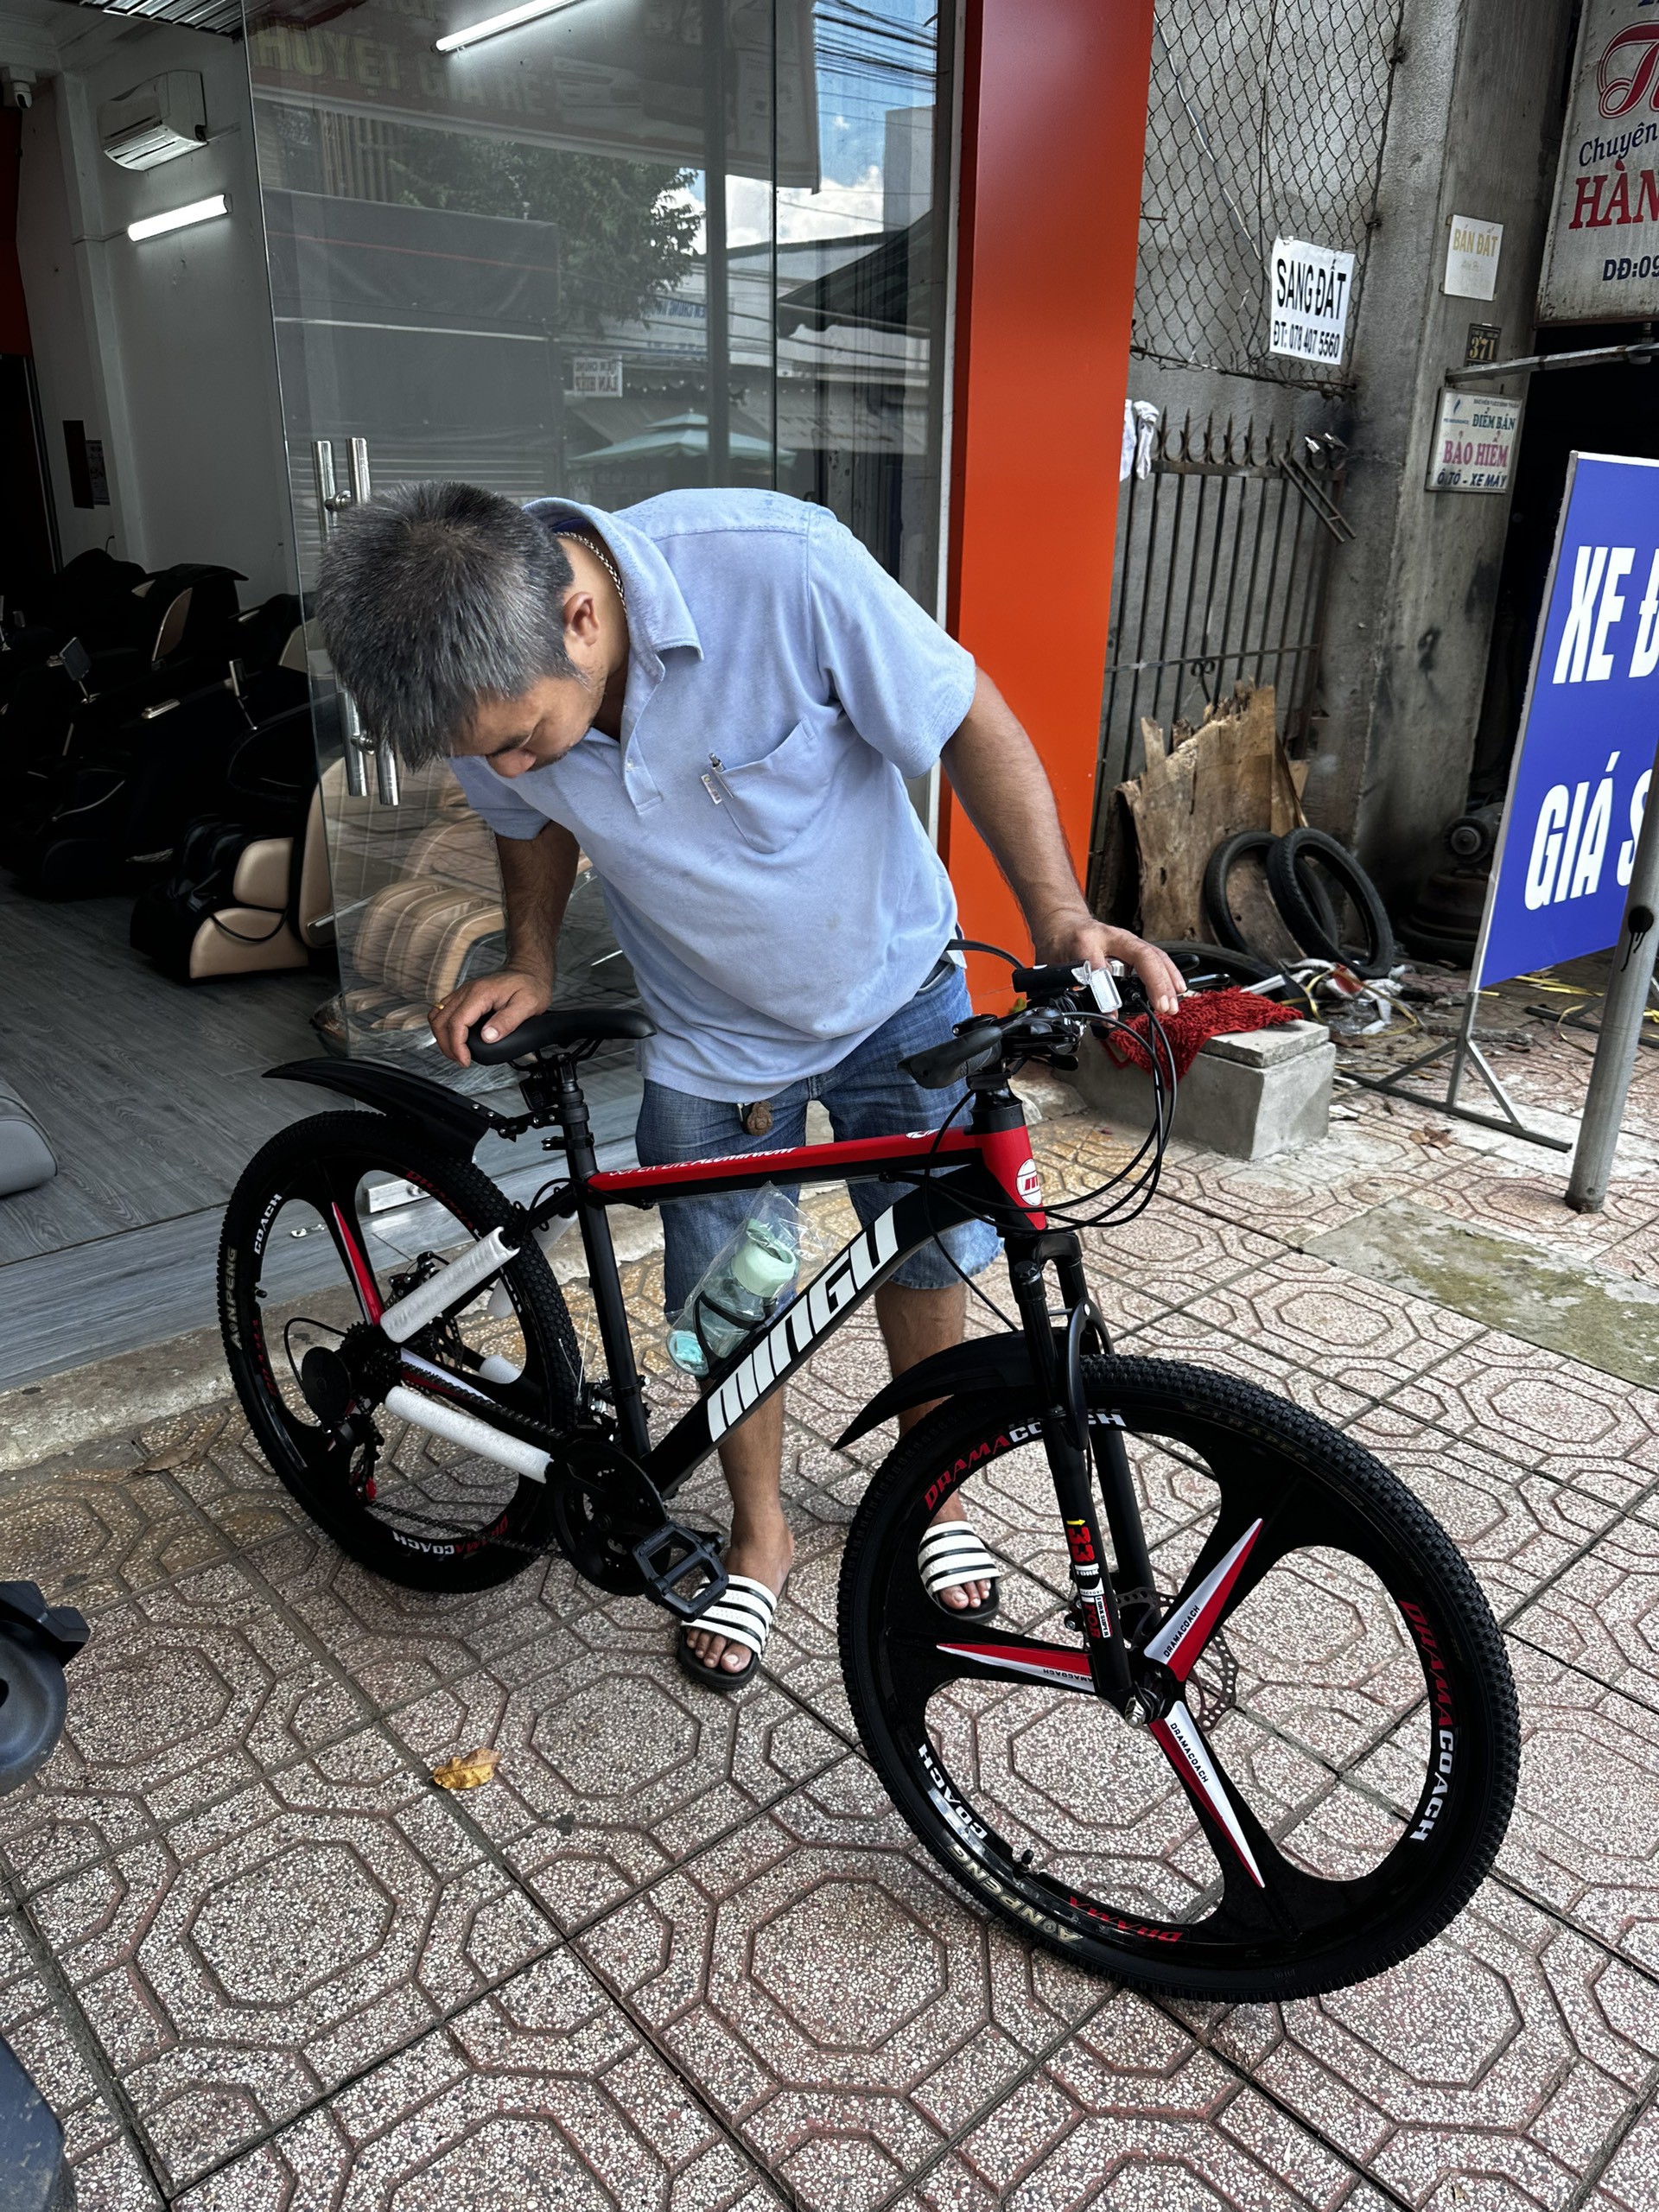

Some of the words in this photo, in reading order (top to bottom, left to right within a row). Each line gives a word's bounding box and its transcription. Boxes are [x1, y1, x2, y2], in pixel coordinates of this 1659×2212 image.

[1580, 122, 1658, 166] Chuyên
[1452, 224, 1475, 253] BÁN
[1477, 227, 1497, 257] ĐẤT
[1277, 258, 1313, 314] SANG
[1314, 259, 1347, 320] ĐẤT
[1274, 321, 1287, 347] ĐT:
[1289, 324, 1302, 351] 078
[1304, 328, 1318, 354] 407
[1319, 332, 1340, 359] 5560
[1469, 336, 1494, 360] 371
[1472, 408, 1496, 429] ĐIỂM
[1496, 413, 1516, 430] BÁN
[1443, 430, 1473, 465] BẢO
[1474, 430, 1510, 467] HIỂM
[1437, 469, 1445, 485] Ô
[1448, 469, 1462, 486] TÔ
[1470, 474, 1484, 486] XE
[1484, 471, 1508, 487] MÁY
[1552, 546, 1636, 684] XE
[1524, 751, 1622, 911] GIÁ
[254, 1193, 283, 1255] COACH
[1163, 1605, 1200, 1658] DRAMACOACH
[1170, 1722, 1209, 1783] DRAMACOACH
[918, 1744, 988, 1840] COACH
